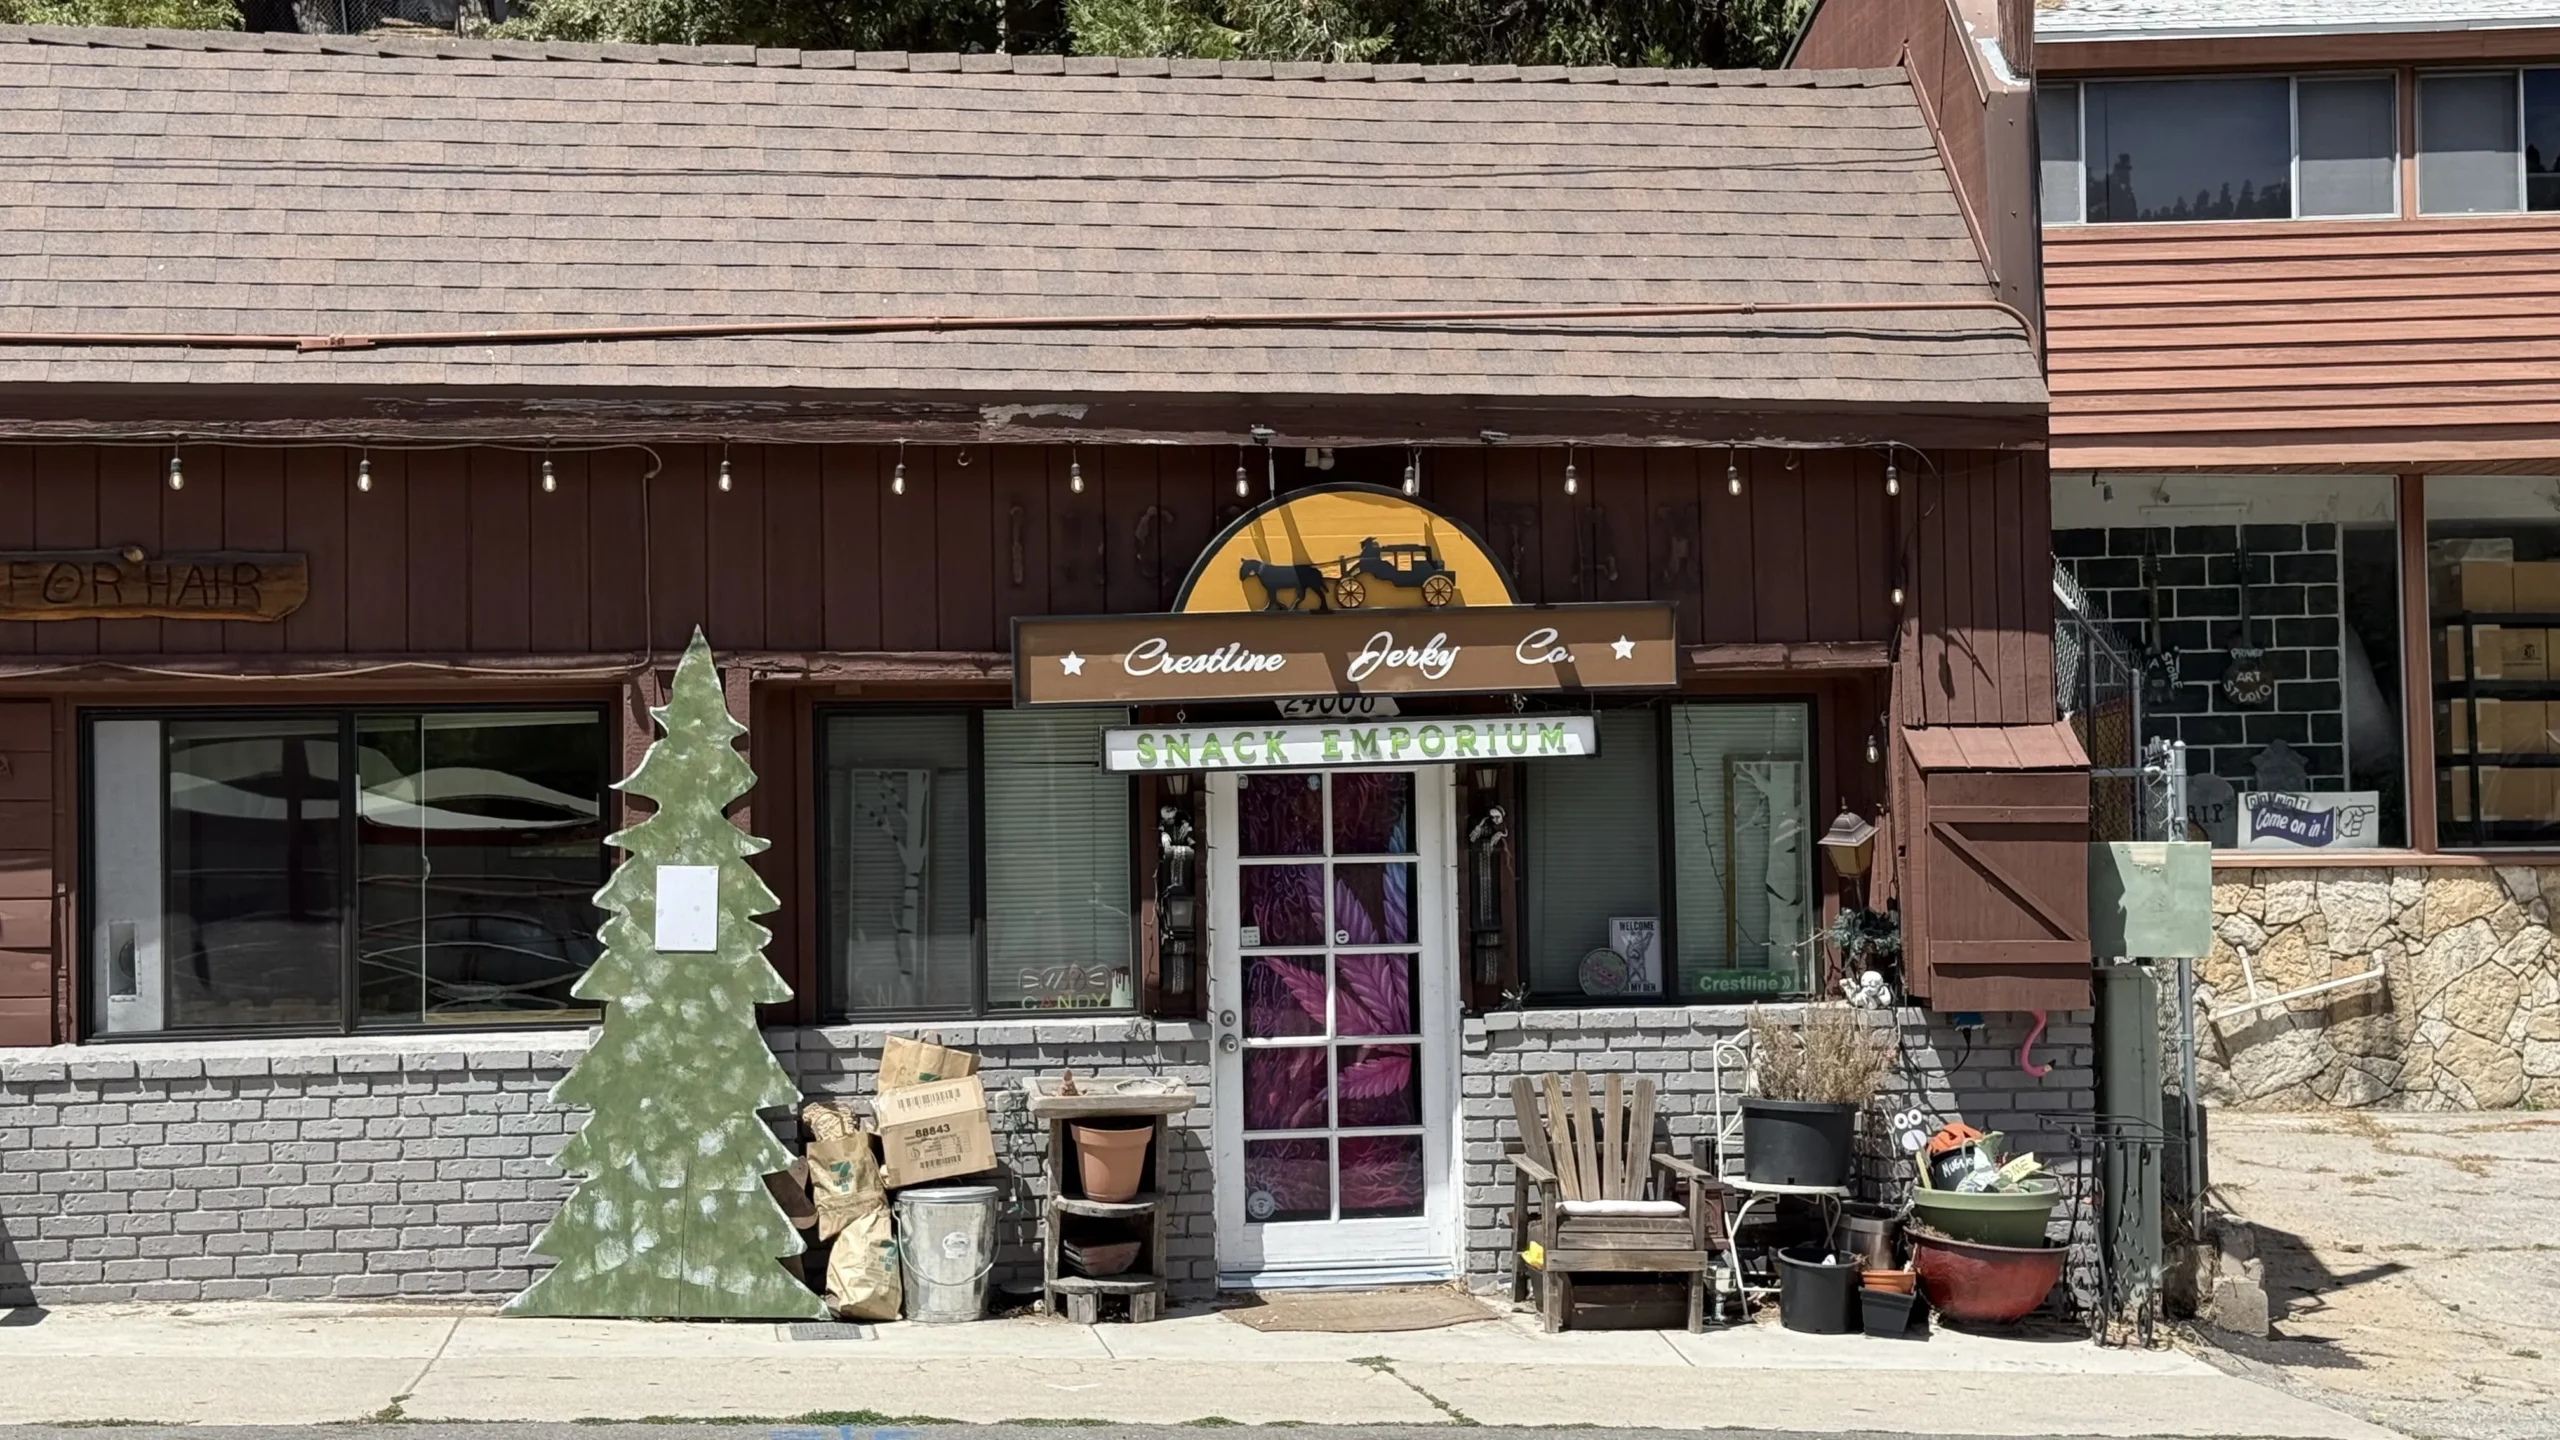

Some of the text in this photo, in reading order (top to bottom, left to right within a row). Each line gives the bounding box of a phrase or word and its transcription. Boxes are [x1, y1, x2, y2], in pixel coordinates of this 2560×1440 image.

[9, 561, 263, 606] FOR HAIR
[1123, 627, 1576, 682] Crestline Jerky Co.
[2161, 651, 2184, 690] STORE
[2236, 671, 2262, 683] ART
[2223, 679, 2272, 703] STUDIO
[1136, 722, 1568, 768] SNACK EMPORIUM
[2255, 807, 2330, 838] Come on in!
[1619, 921, 1655, 931] WELCOME
[1700, 976, 1779, 991] Crestline
[1021, 993, 1106, 1010] CANDY
[915, 1123, 951, 1138] 88843
